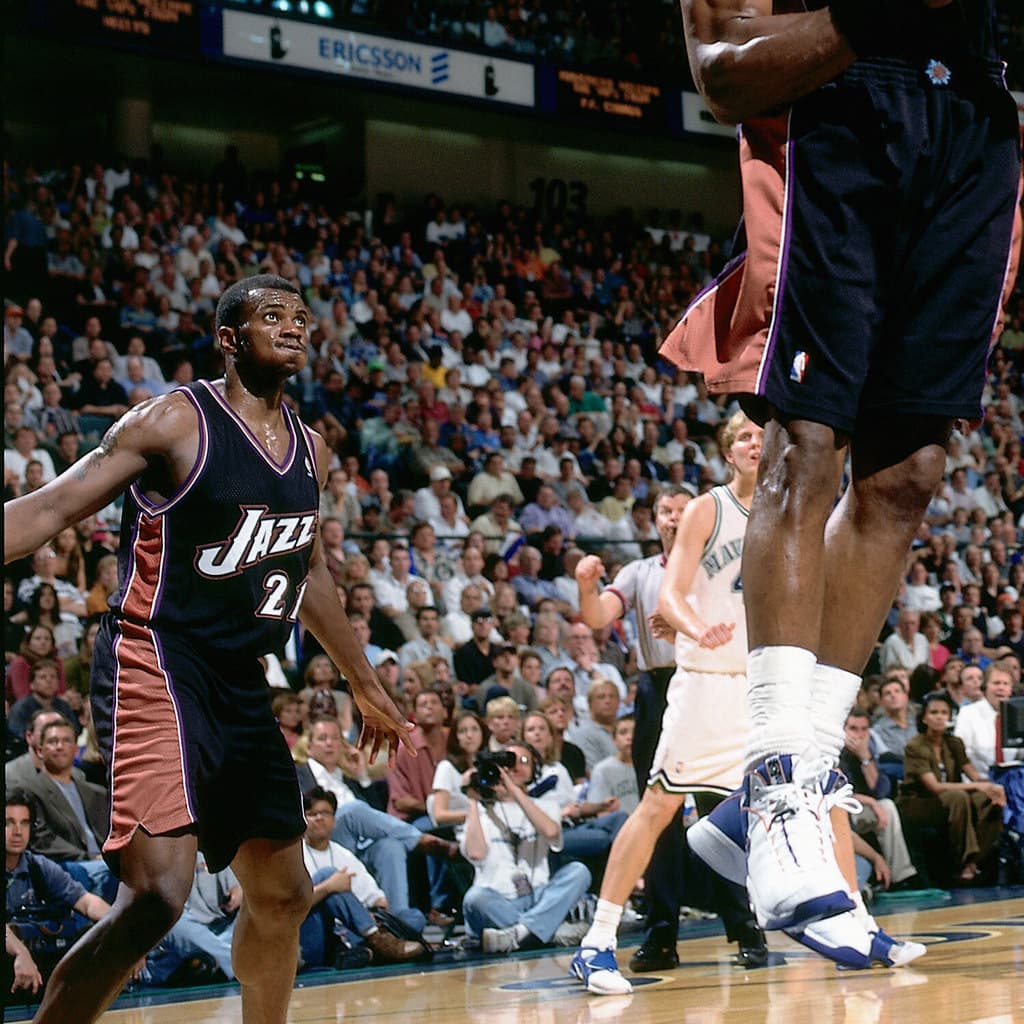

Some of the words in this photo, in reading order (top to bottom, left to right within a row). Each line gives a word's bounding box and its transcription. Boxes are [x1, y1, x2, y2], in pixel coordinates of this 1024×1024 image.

[318, 36, 422, 74] ERICSSON
[529, 177, 589, 218] 103
[193, 505, 319, 580] JAZZ
